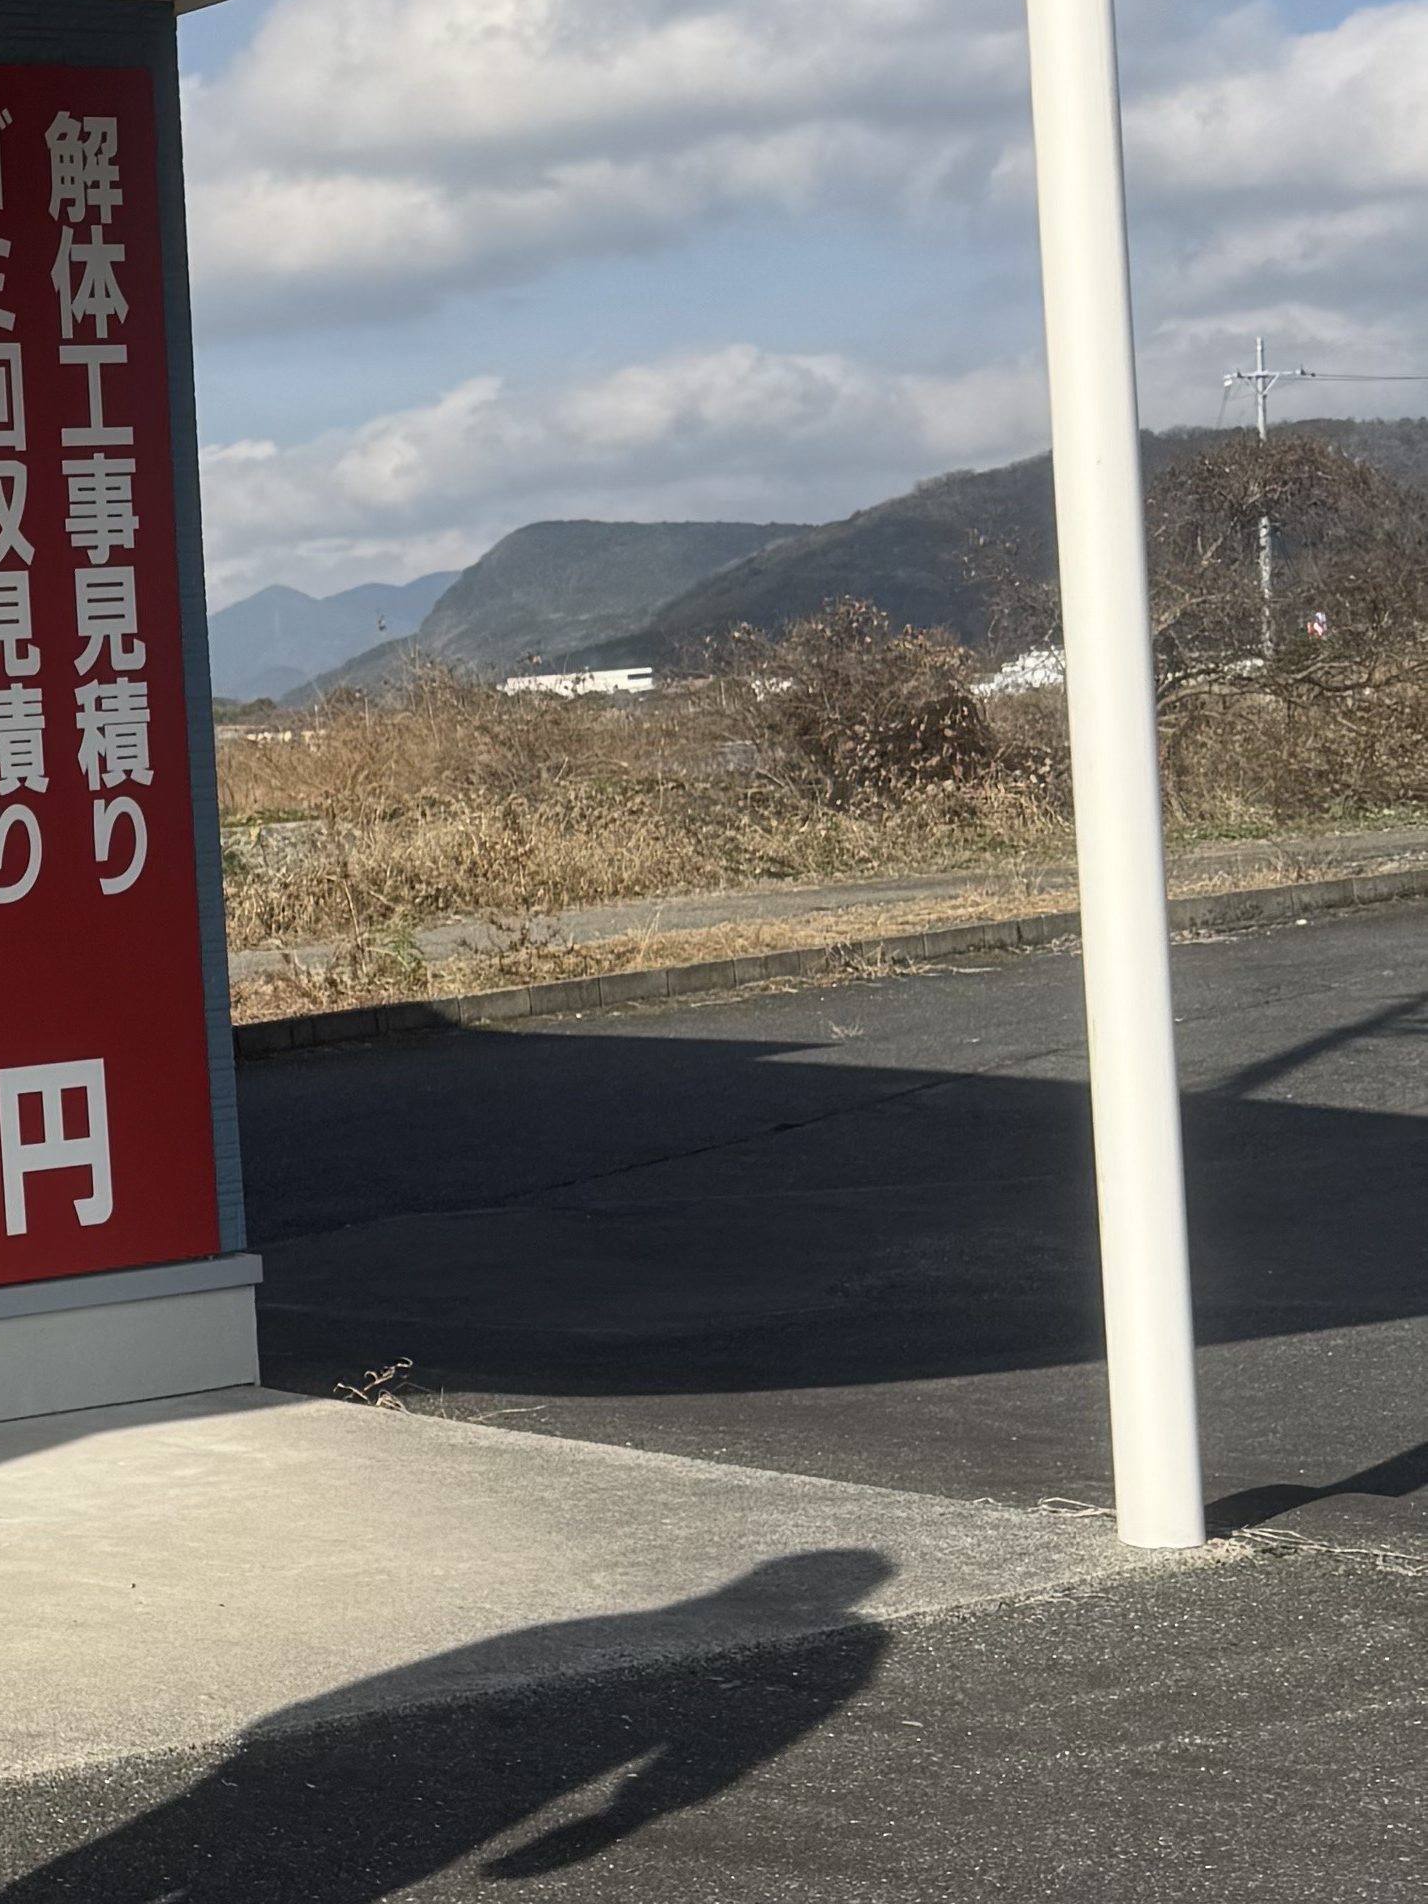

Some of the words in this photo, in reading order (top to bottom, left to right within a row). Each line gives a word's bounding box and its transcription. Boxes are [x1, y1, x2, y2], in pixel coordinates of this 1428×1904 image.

[45, 111, 155, 896] 解体工事見積り
